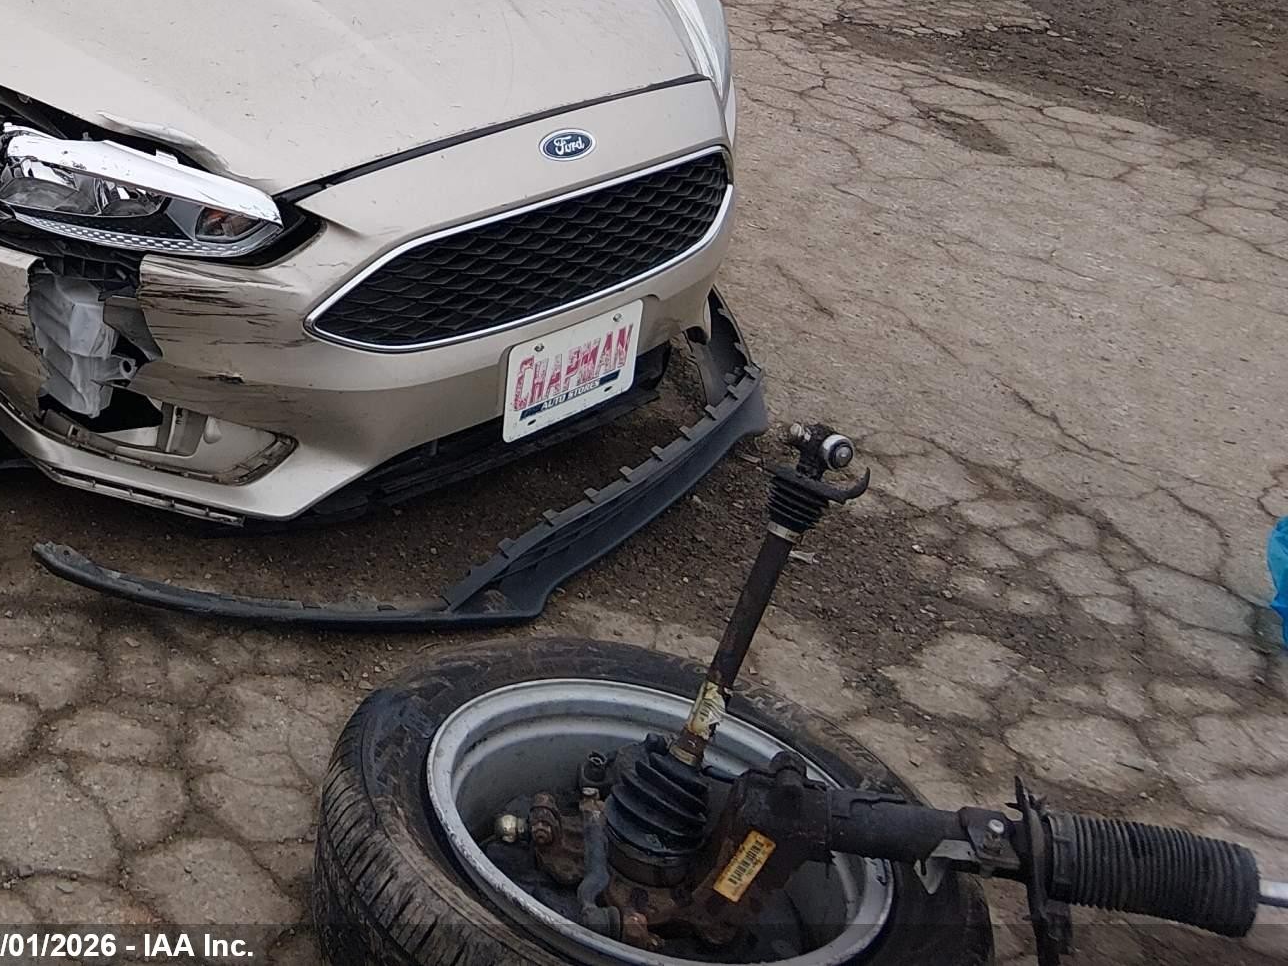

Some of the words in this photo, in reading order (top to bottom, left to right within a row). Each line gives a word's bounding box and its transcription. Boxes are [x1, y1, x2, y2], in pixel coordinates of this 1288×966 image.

[553, 135, 585, 155] Ford
[513, 323, 634, 411] CHAPMAN
[541, 394, 566, 411] AUTO
